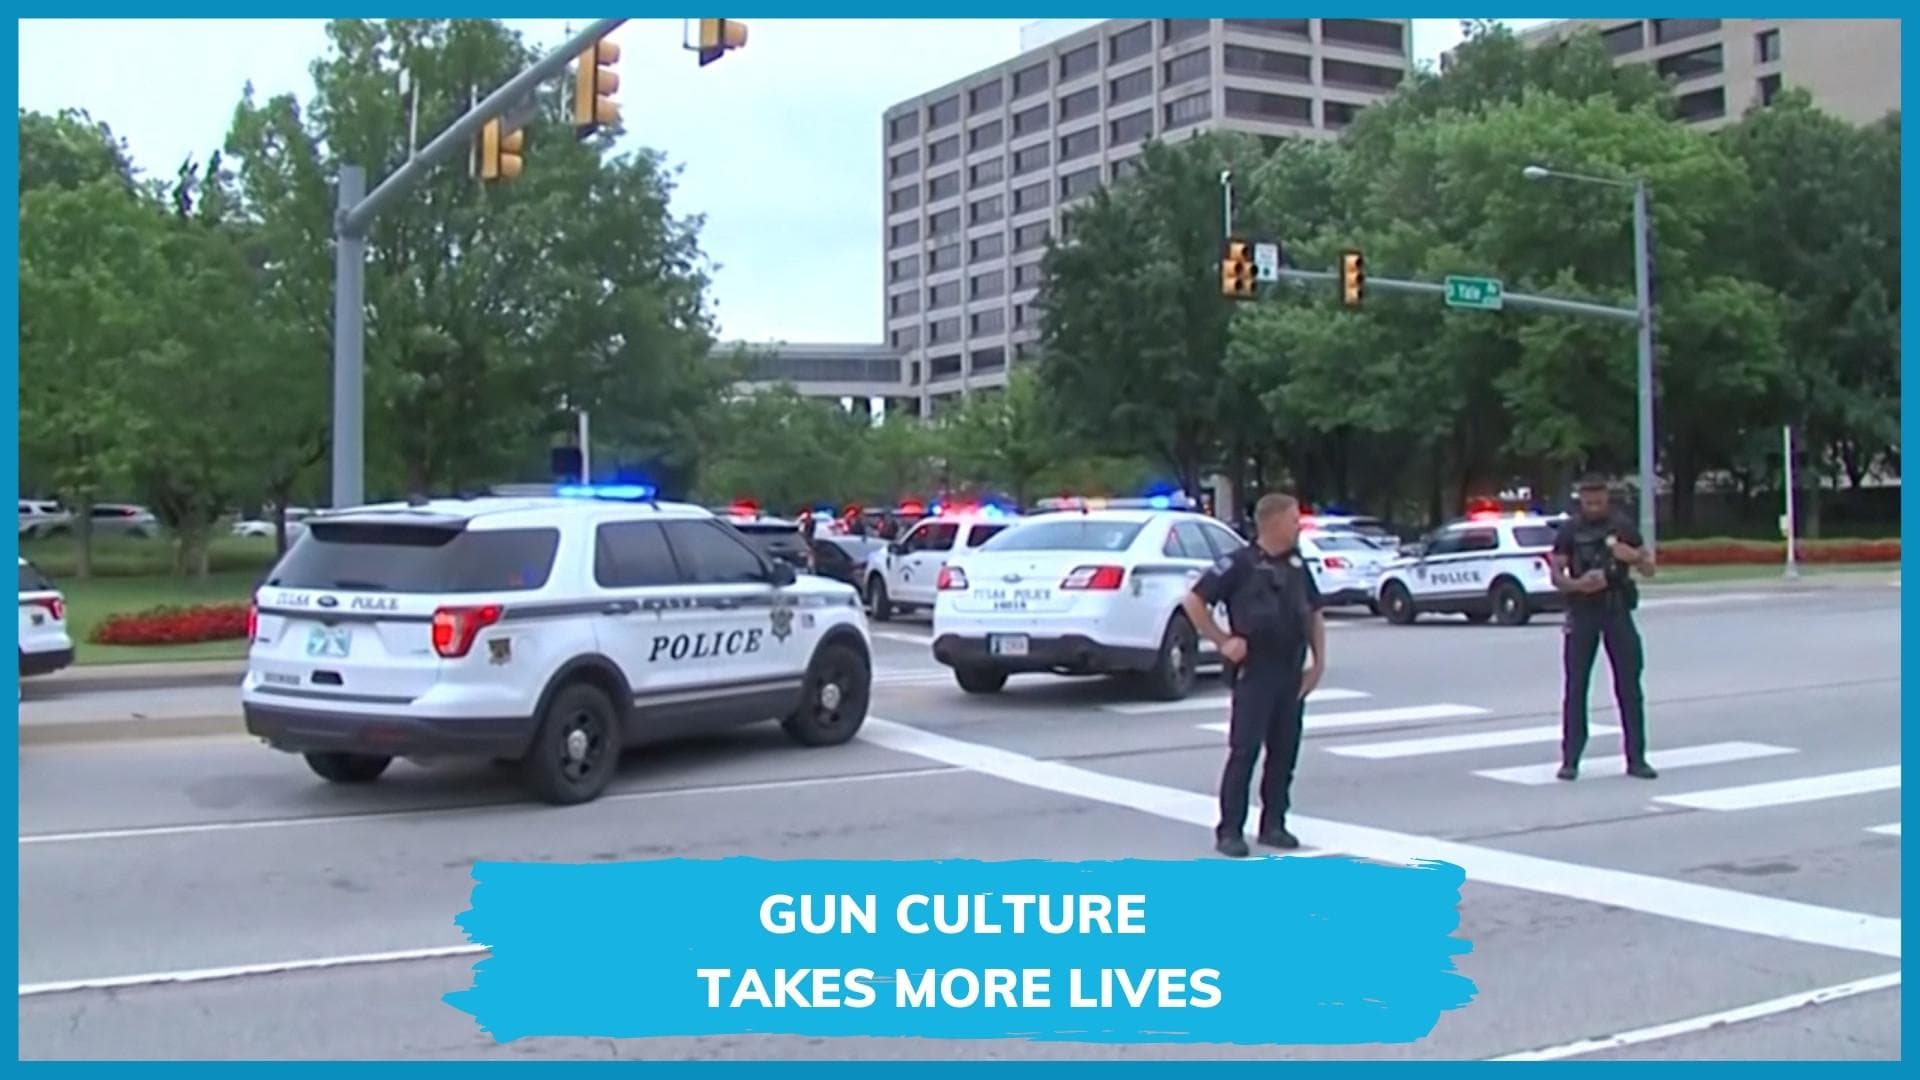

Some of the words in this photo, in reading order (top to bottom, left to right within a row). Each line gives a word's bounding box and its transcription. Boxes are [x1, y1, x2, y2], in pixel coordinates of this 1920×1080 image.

[1458, 283, 1481, 300] Yale
[1430, 571, 1480, 586] POLICE
[351, 596, 400, 610] POLICE
[648, 627, 764, 663] POLICE
